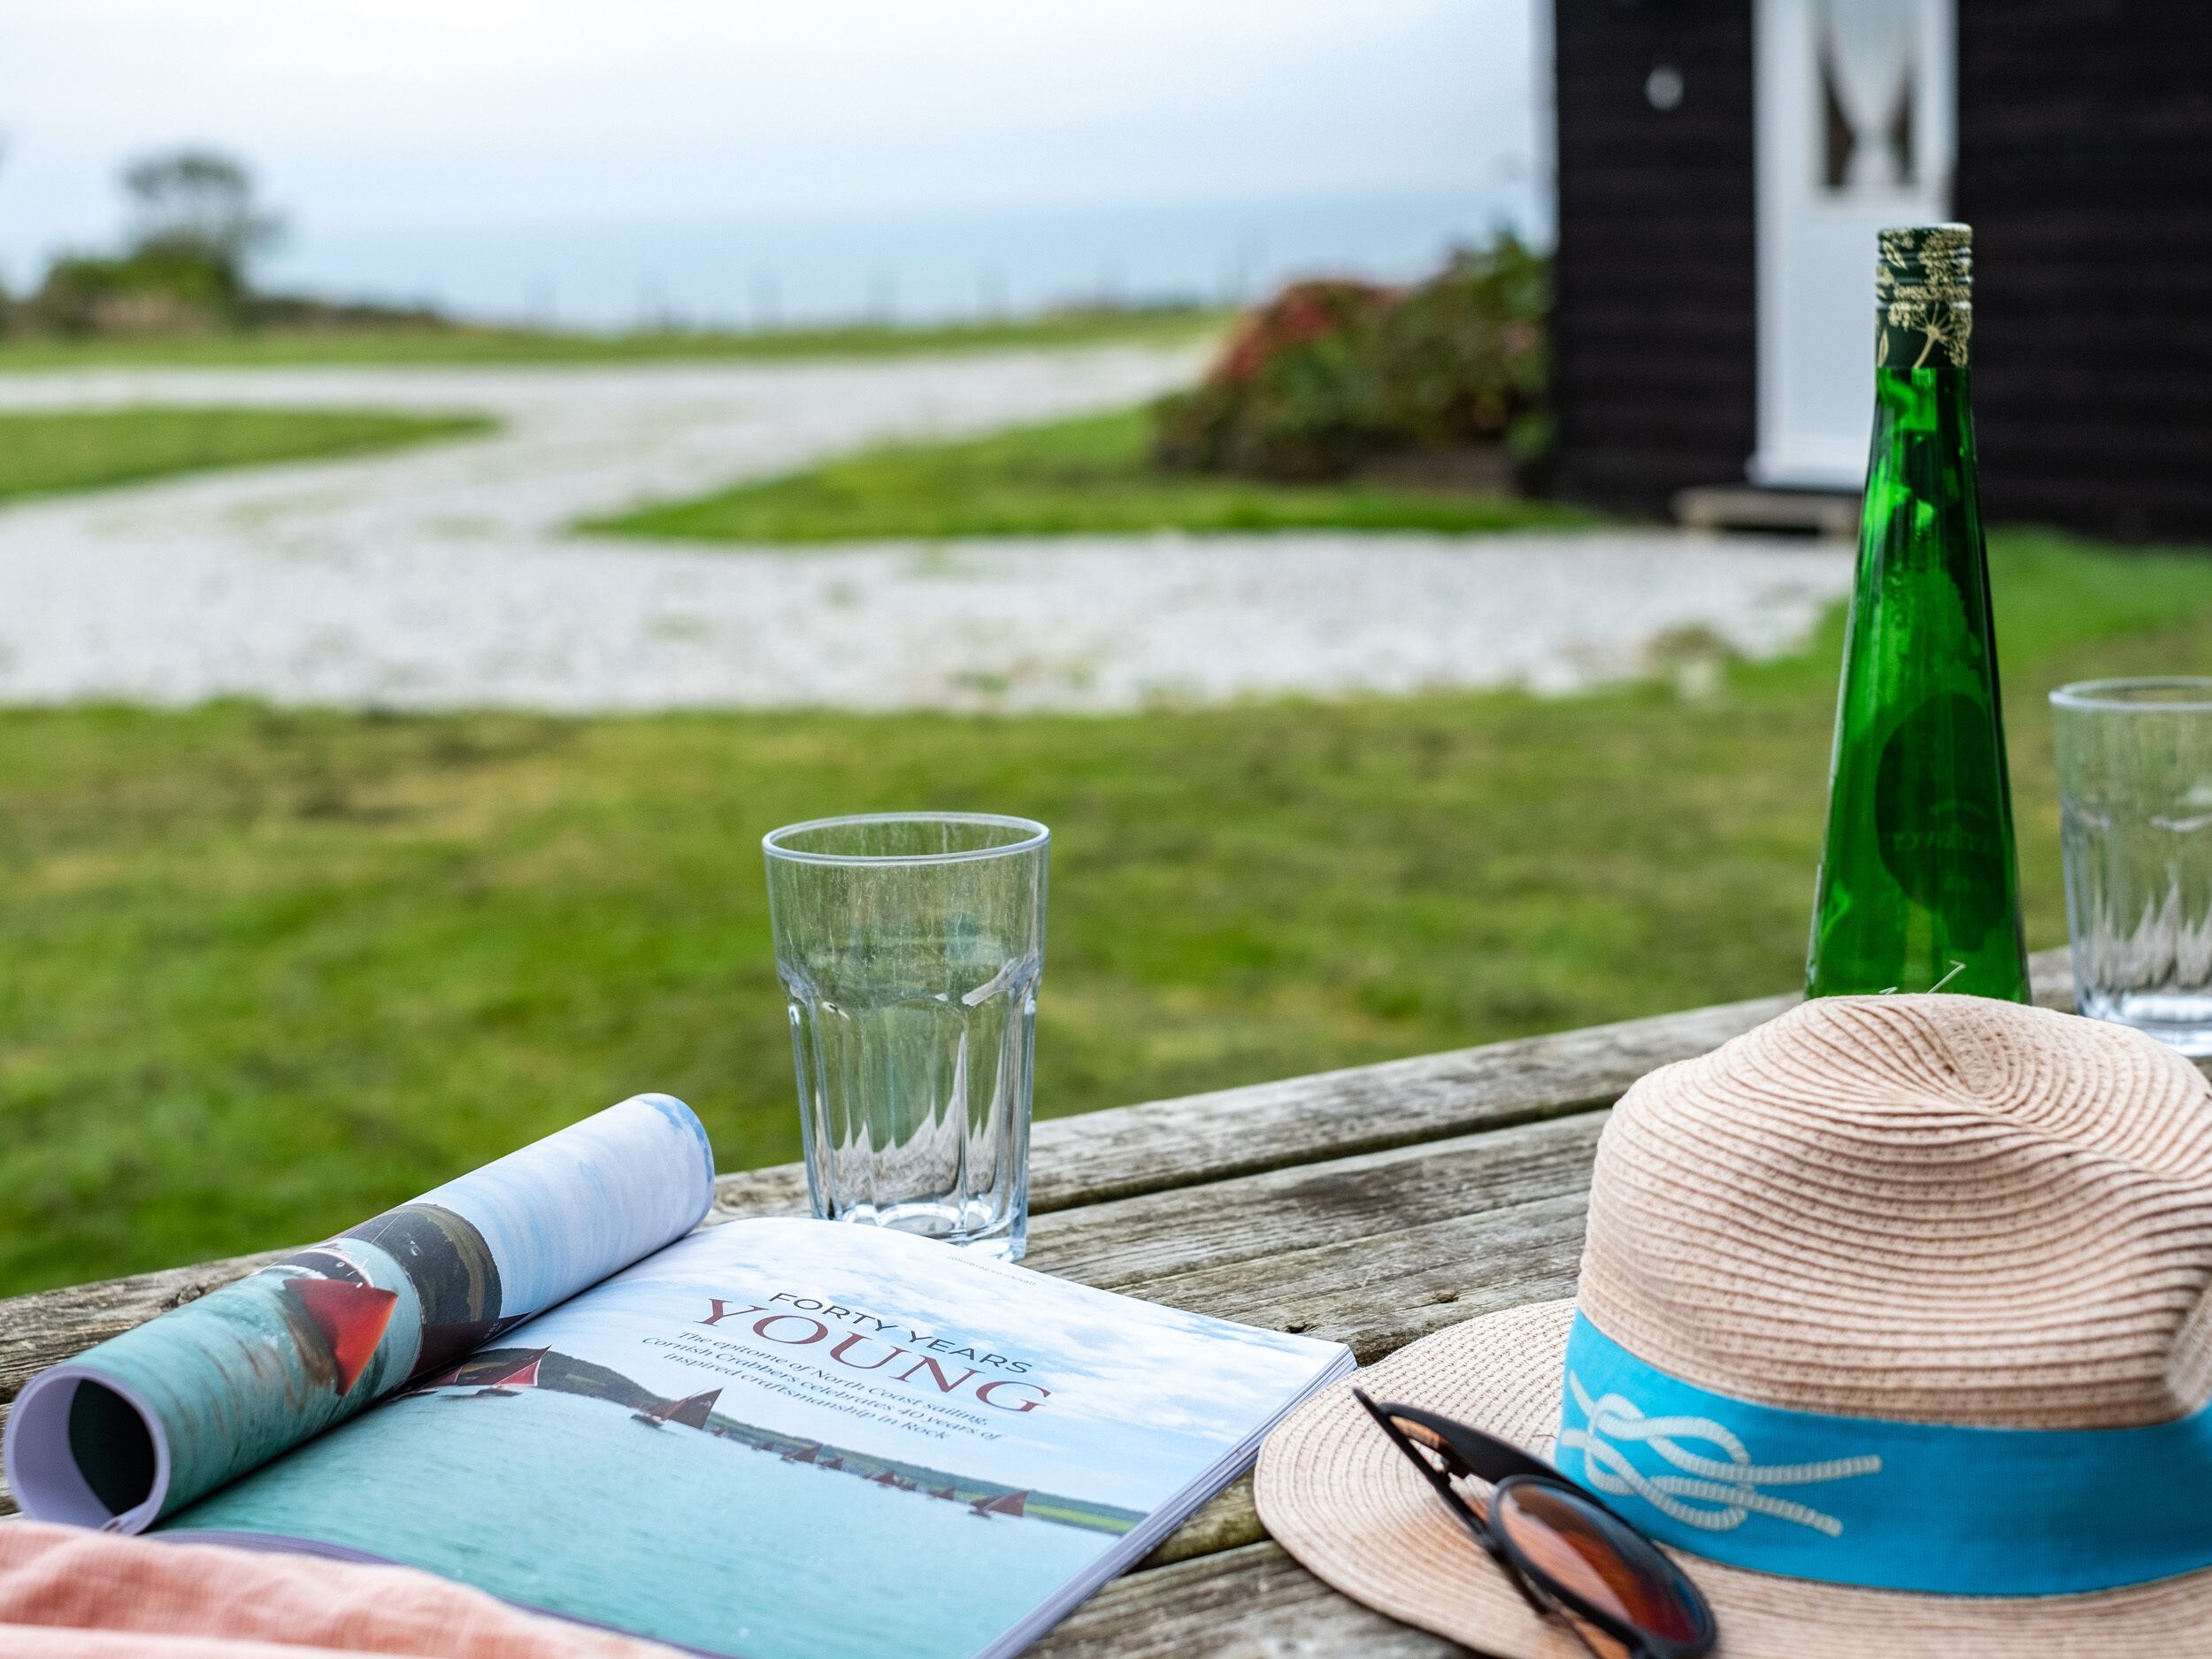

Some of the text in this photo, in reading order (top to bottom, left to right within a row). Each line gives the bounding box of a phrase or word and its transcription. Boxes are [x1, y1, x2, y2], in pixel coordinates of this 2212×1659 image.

[678, 1331, 712, 1344] The
[713, 1340, 788, 1364] epitome
[789, 1363, 815, 1372] of
[810, 1370, 865, 1391] North
[868, 1387, 925, 1405] Coast
[693, 1298, 1051, 1412] YOUNG
[769, 1293, 1033, 1373] FORTY YEARS
[642, 1337, 1007, 1440] Cornish Crabbers celebrates 40 years of
[664, 1352, 950, 1440] inspired craftsmanship in Rock
